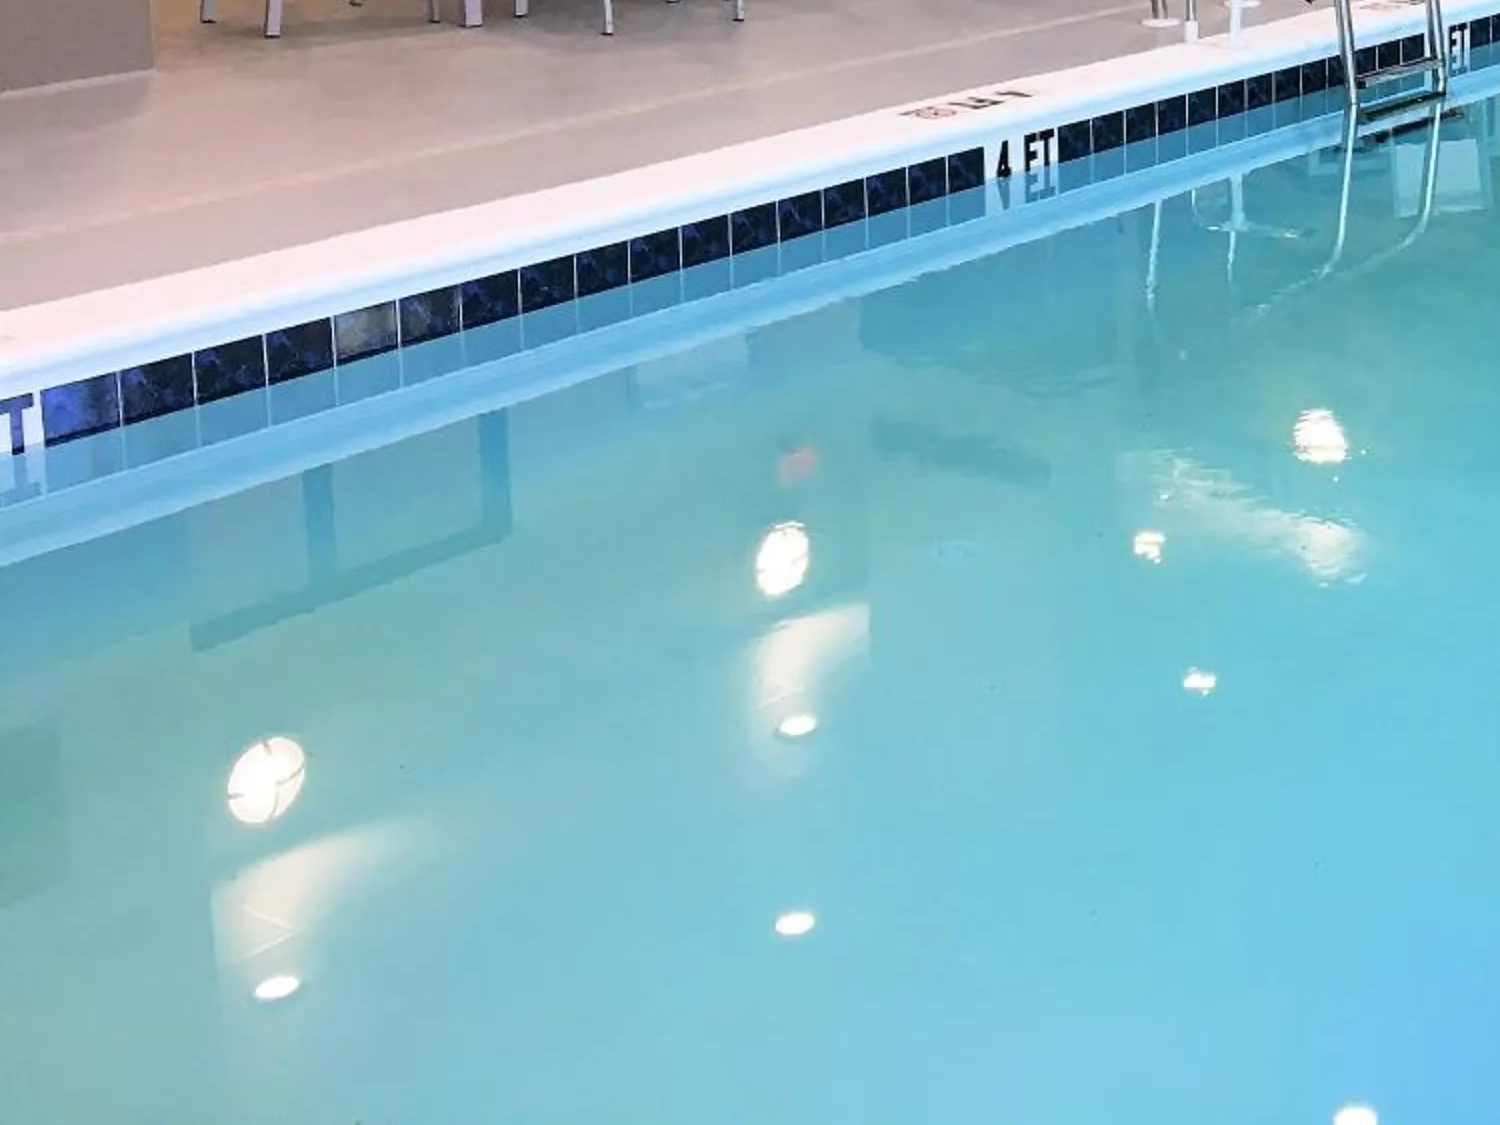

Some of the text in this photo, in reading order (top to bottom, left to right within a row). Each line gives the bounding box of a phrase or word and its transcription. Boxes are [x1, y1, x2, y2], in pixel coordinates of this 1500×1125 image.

[1448, 22, 1468, 55] FT
[997, 128, 1055, 177] 4 FT
